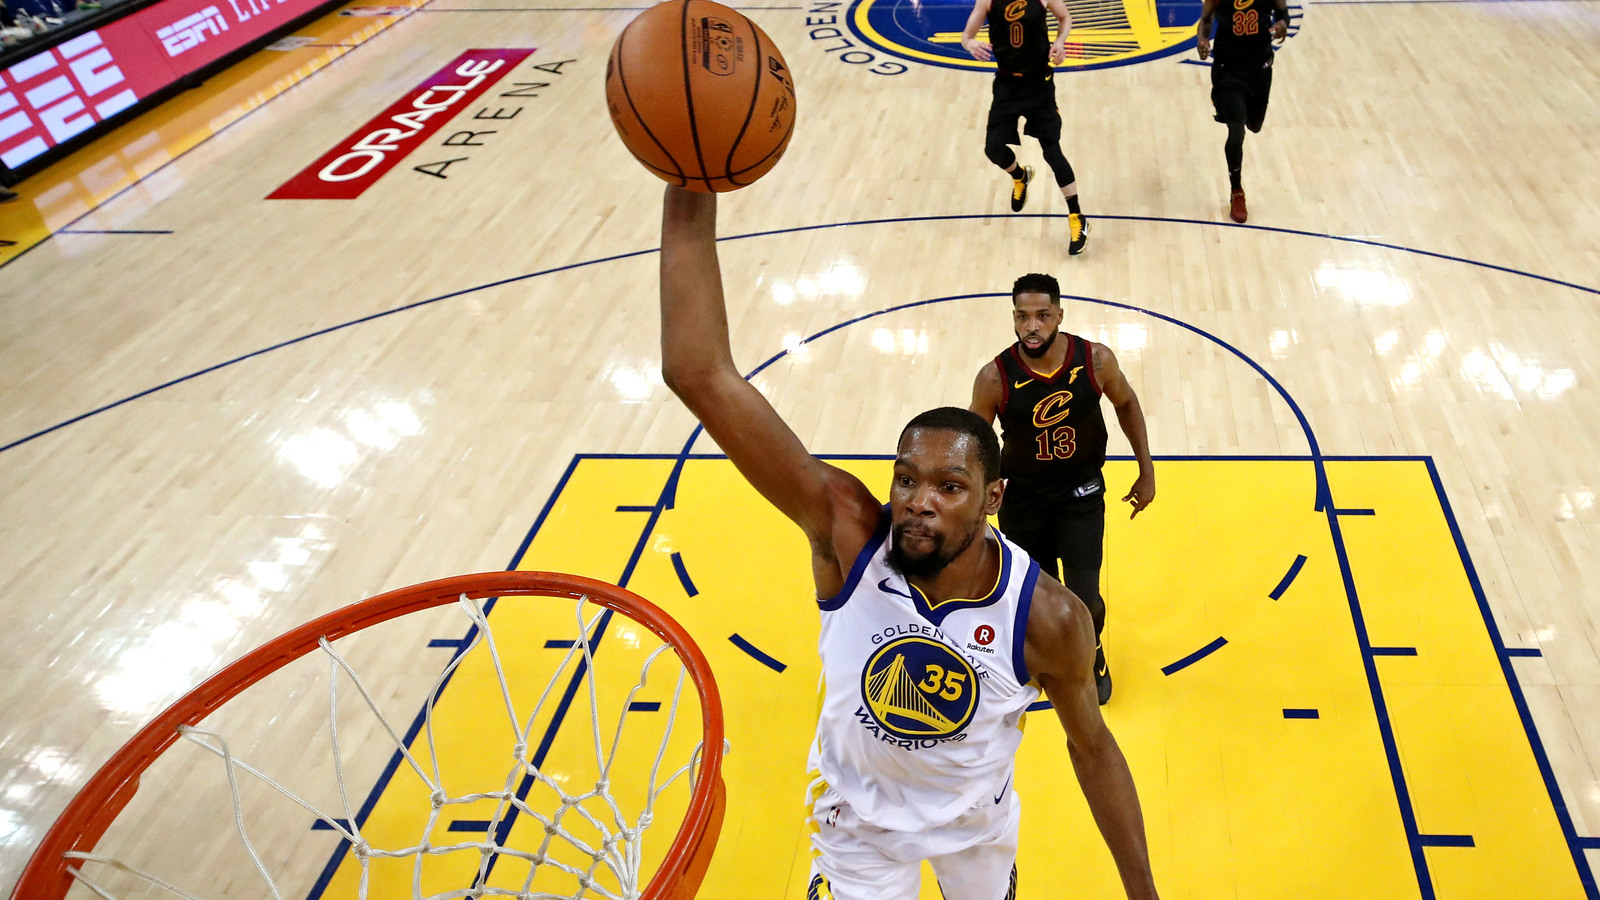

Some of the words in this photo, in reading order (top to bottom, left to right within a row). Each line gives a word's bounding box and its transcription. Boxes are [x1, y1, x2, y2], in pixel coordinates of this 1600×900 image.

[156, 5, 229, 57] ESPN
[805, 2, 908, 76] GOLDEN
[1009, 21, 1024, 48] 0
[1232, 9, 1259, 36] 32
[318, 58, 505, 182] ORACLE
[413, 58, 577, 179] ARENA
[1035, 425, 1077, 460] 13
[871, 623, 944, 645] GOLDEN
[966, 642, 995, 655] Rakuten
[918, 664, 967, 702] 35
